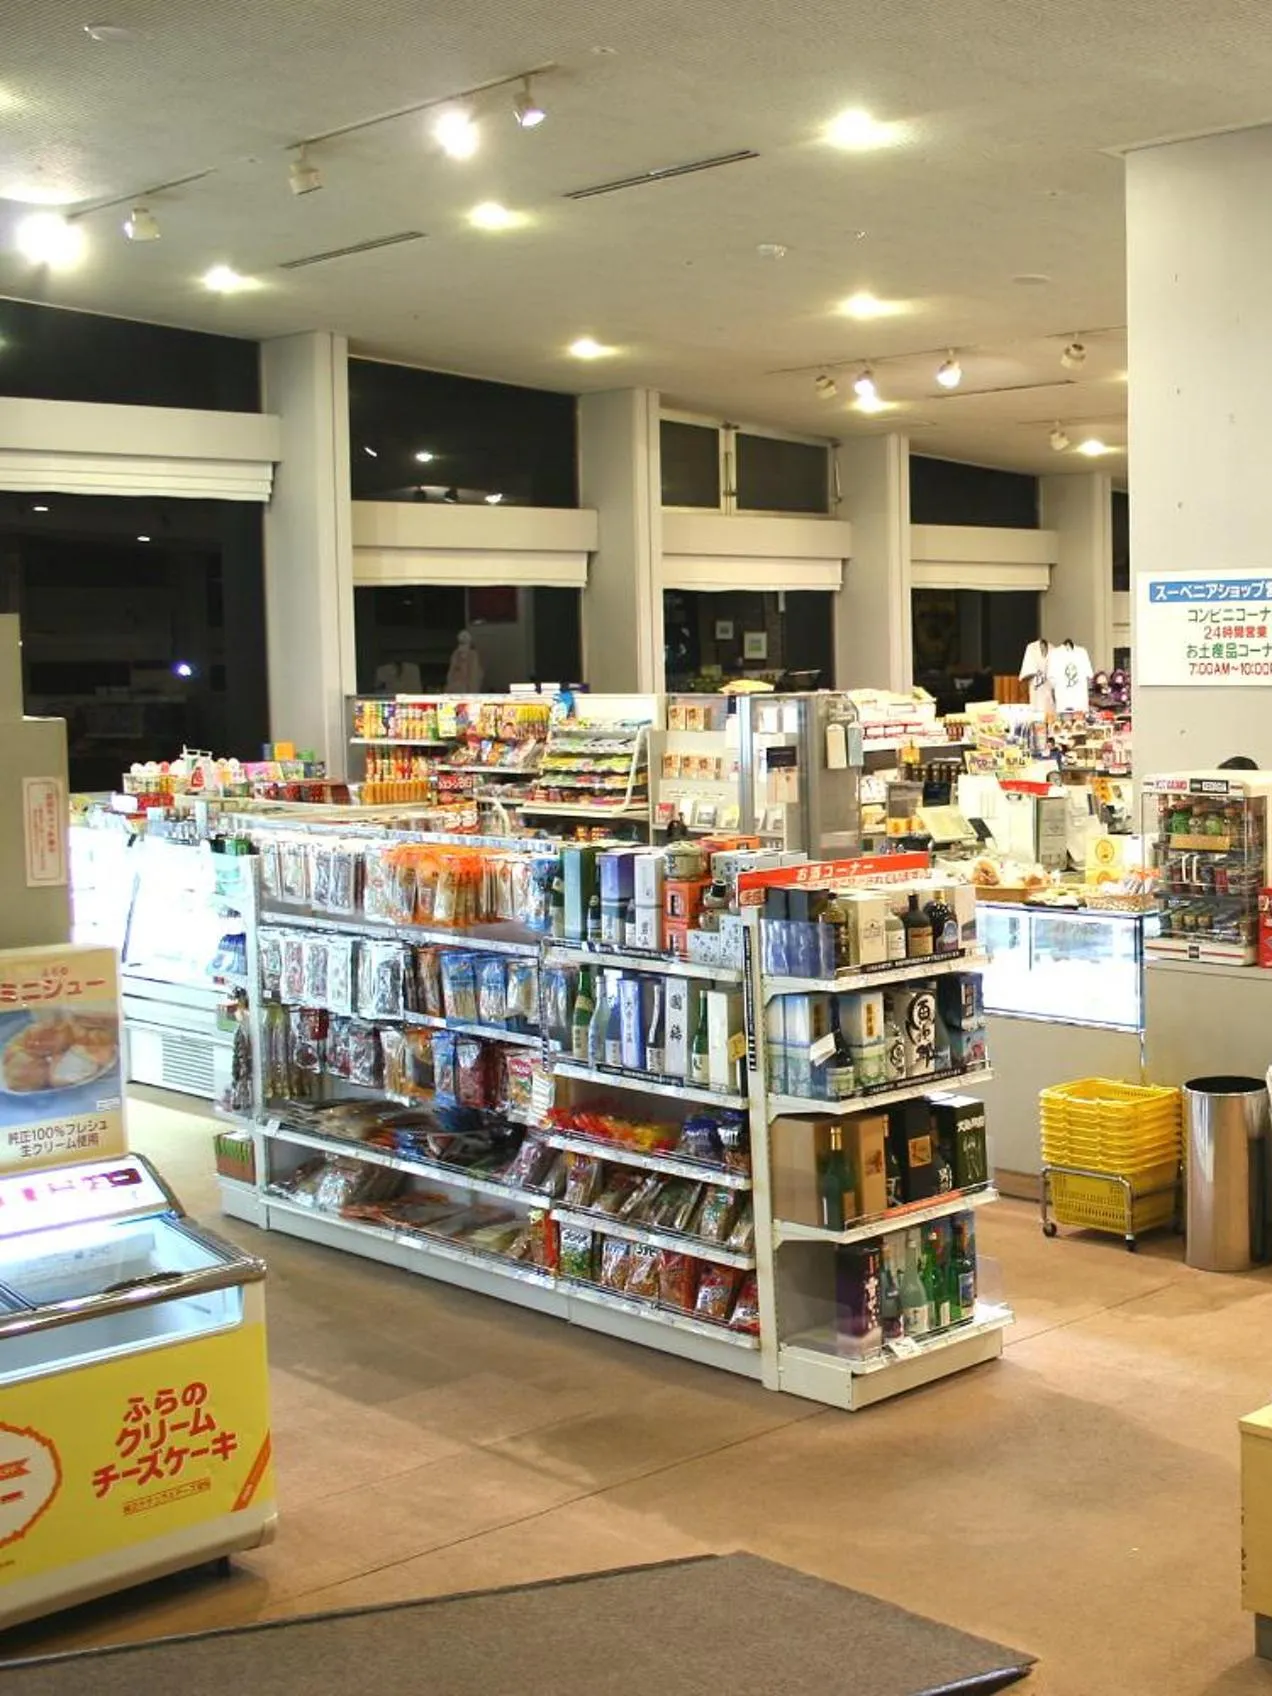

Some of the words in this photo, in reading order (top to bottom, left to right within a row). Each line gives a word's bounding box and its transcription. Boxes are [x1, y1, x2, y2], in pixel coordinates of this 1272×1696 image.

[1203, 625, 1268, 640] 24時間営業
[795, 863, 875, 882] お酒コーナー
[20, 1132, 100, 1158] 生クリーム使用
[122, 1381, 209, 1423] ふらの
[115, 1406, 217, 1459] クリーム
[91, 1430, 239, 1499] チーズケーキ
